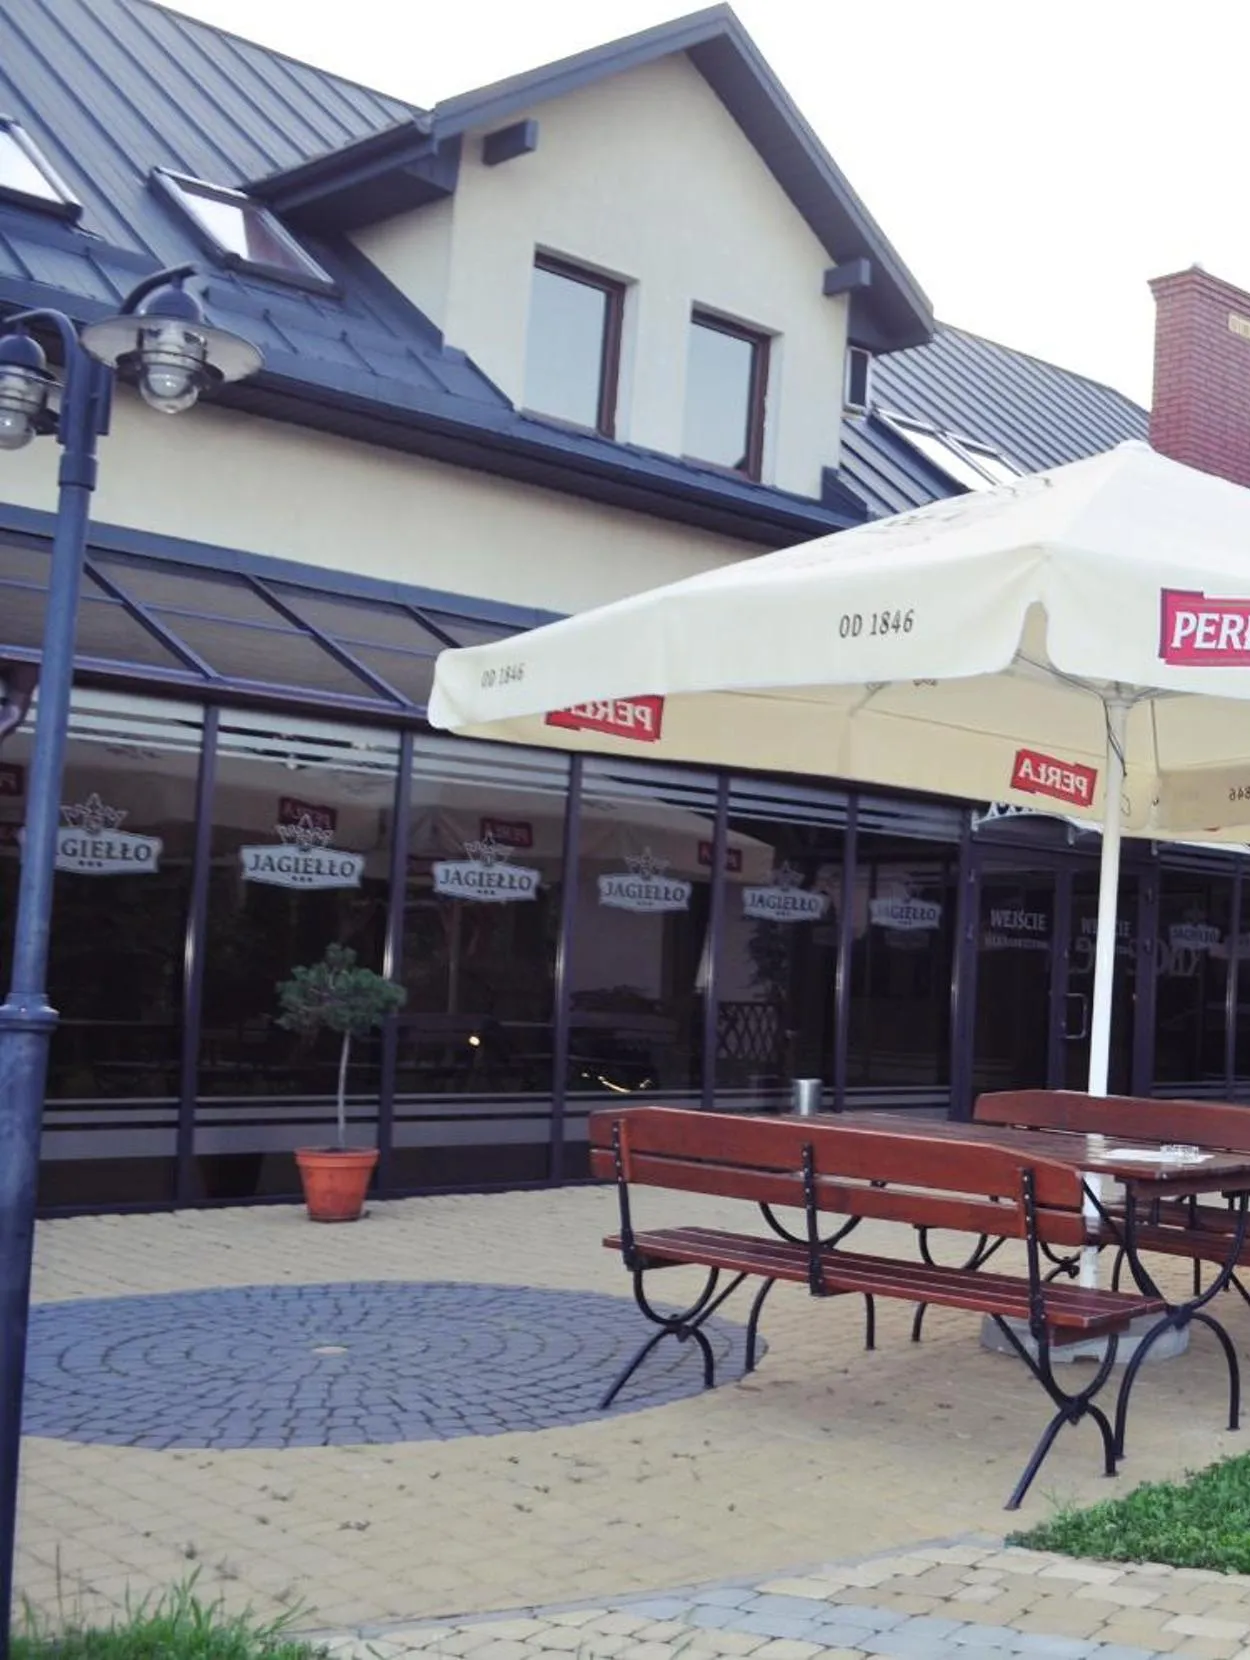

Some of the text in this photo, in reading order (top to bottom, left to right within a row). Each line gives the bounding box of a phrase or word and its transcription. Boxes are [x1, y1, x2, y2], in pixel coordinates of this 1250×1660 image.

[839, 607, 915, 639] OD 1846
[498, 661, 526, 686] 1846
[58, 837, 152, 864] GIEŁŁO
[248, 853, 356, 878] JAGIEŁŁO
[439, 868, 532, 891] JAGIEŁŁO
[605, 881, 685, 902] JAGIEŁŁO
